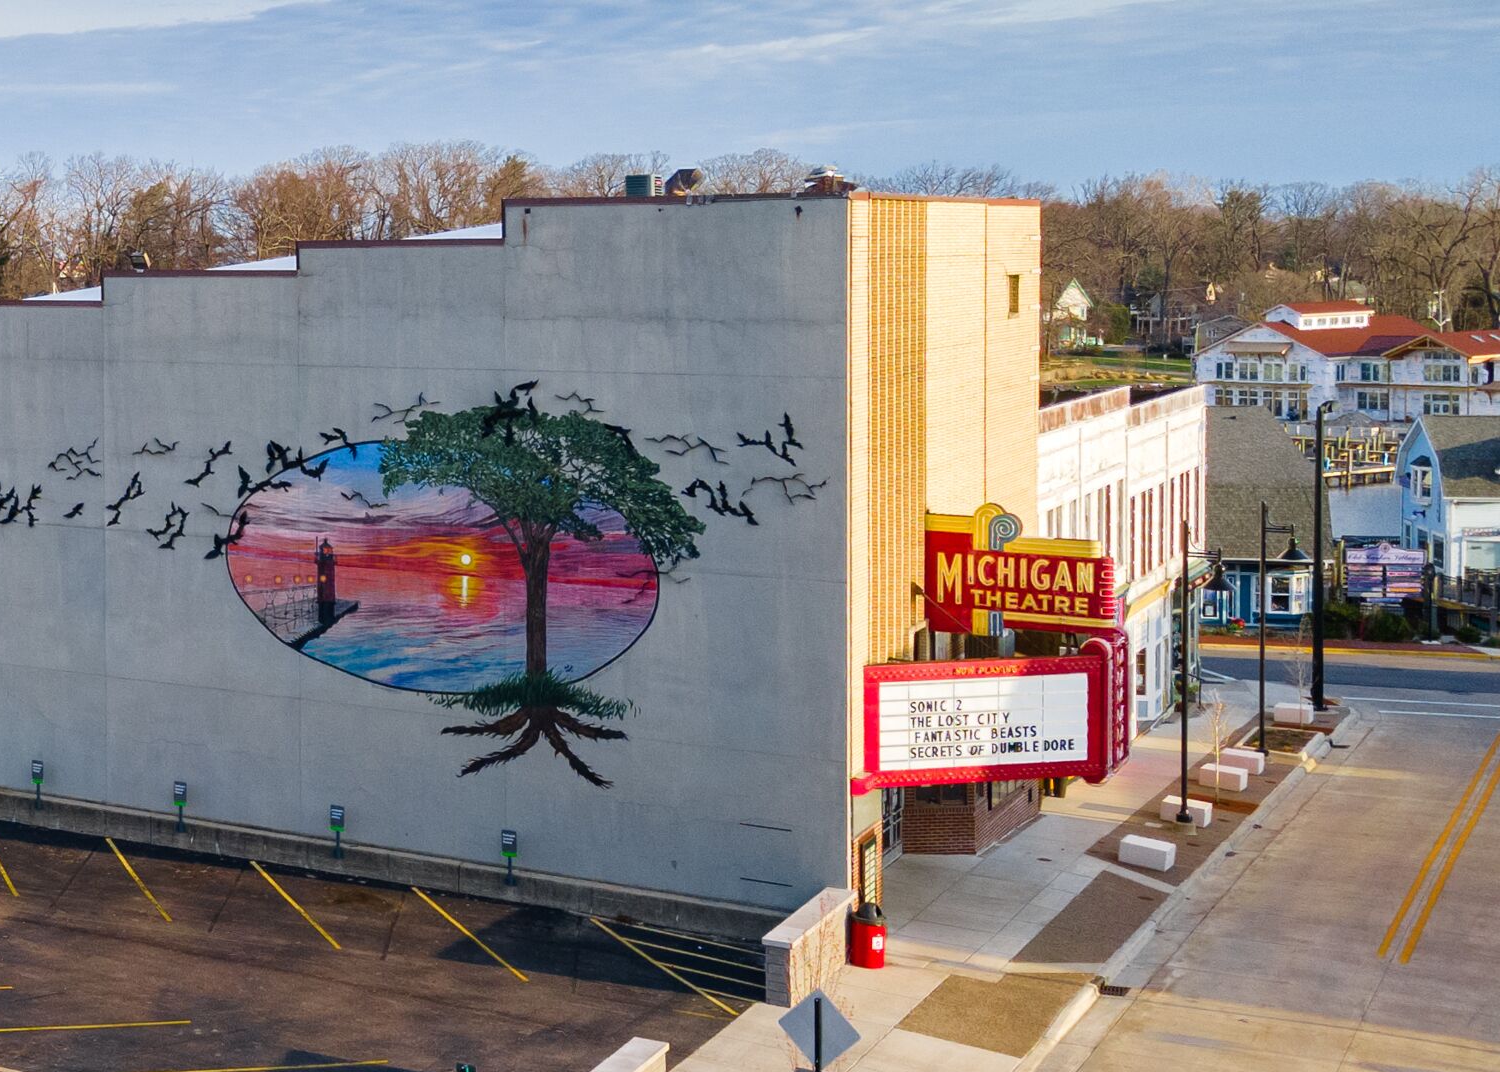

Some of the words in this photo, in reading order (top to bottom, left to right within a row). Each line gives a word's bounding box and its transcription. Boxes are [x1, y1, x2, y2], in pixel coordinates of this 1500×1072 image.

[936, 551, 1095, 605] MICHIGAN
[970, 588, 1090, 616] THEATRE
[953, 666, 975, 676] NOW
[976, 664, 1020, 675] PLAYING
[910, 700, 947, 713] SONIC
[956, 699, 962, 711] 2
[910, 716, 932, 728] THE
[938, 714, 969, 727] LOST
[977, 712, 1011, 725] CITY
[914, 728, 981, 743] FANTASTIC
[991, 725, 1037, 740] BEASTS
[910, 744, 962, 758] SECRETS
[969, 745, 985, 756] OF
